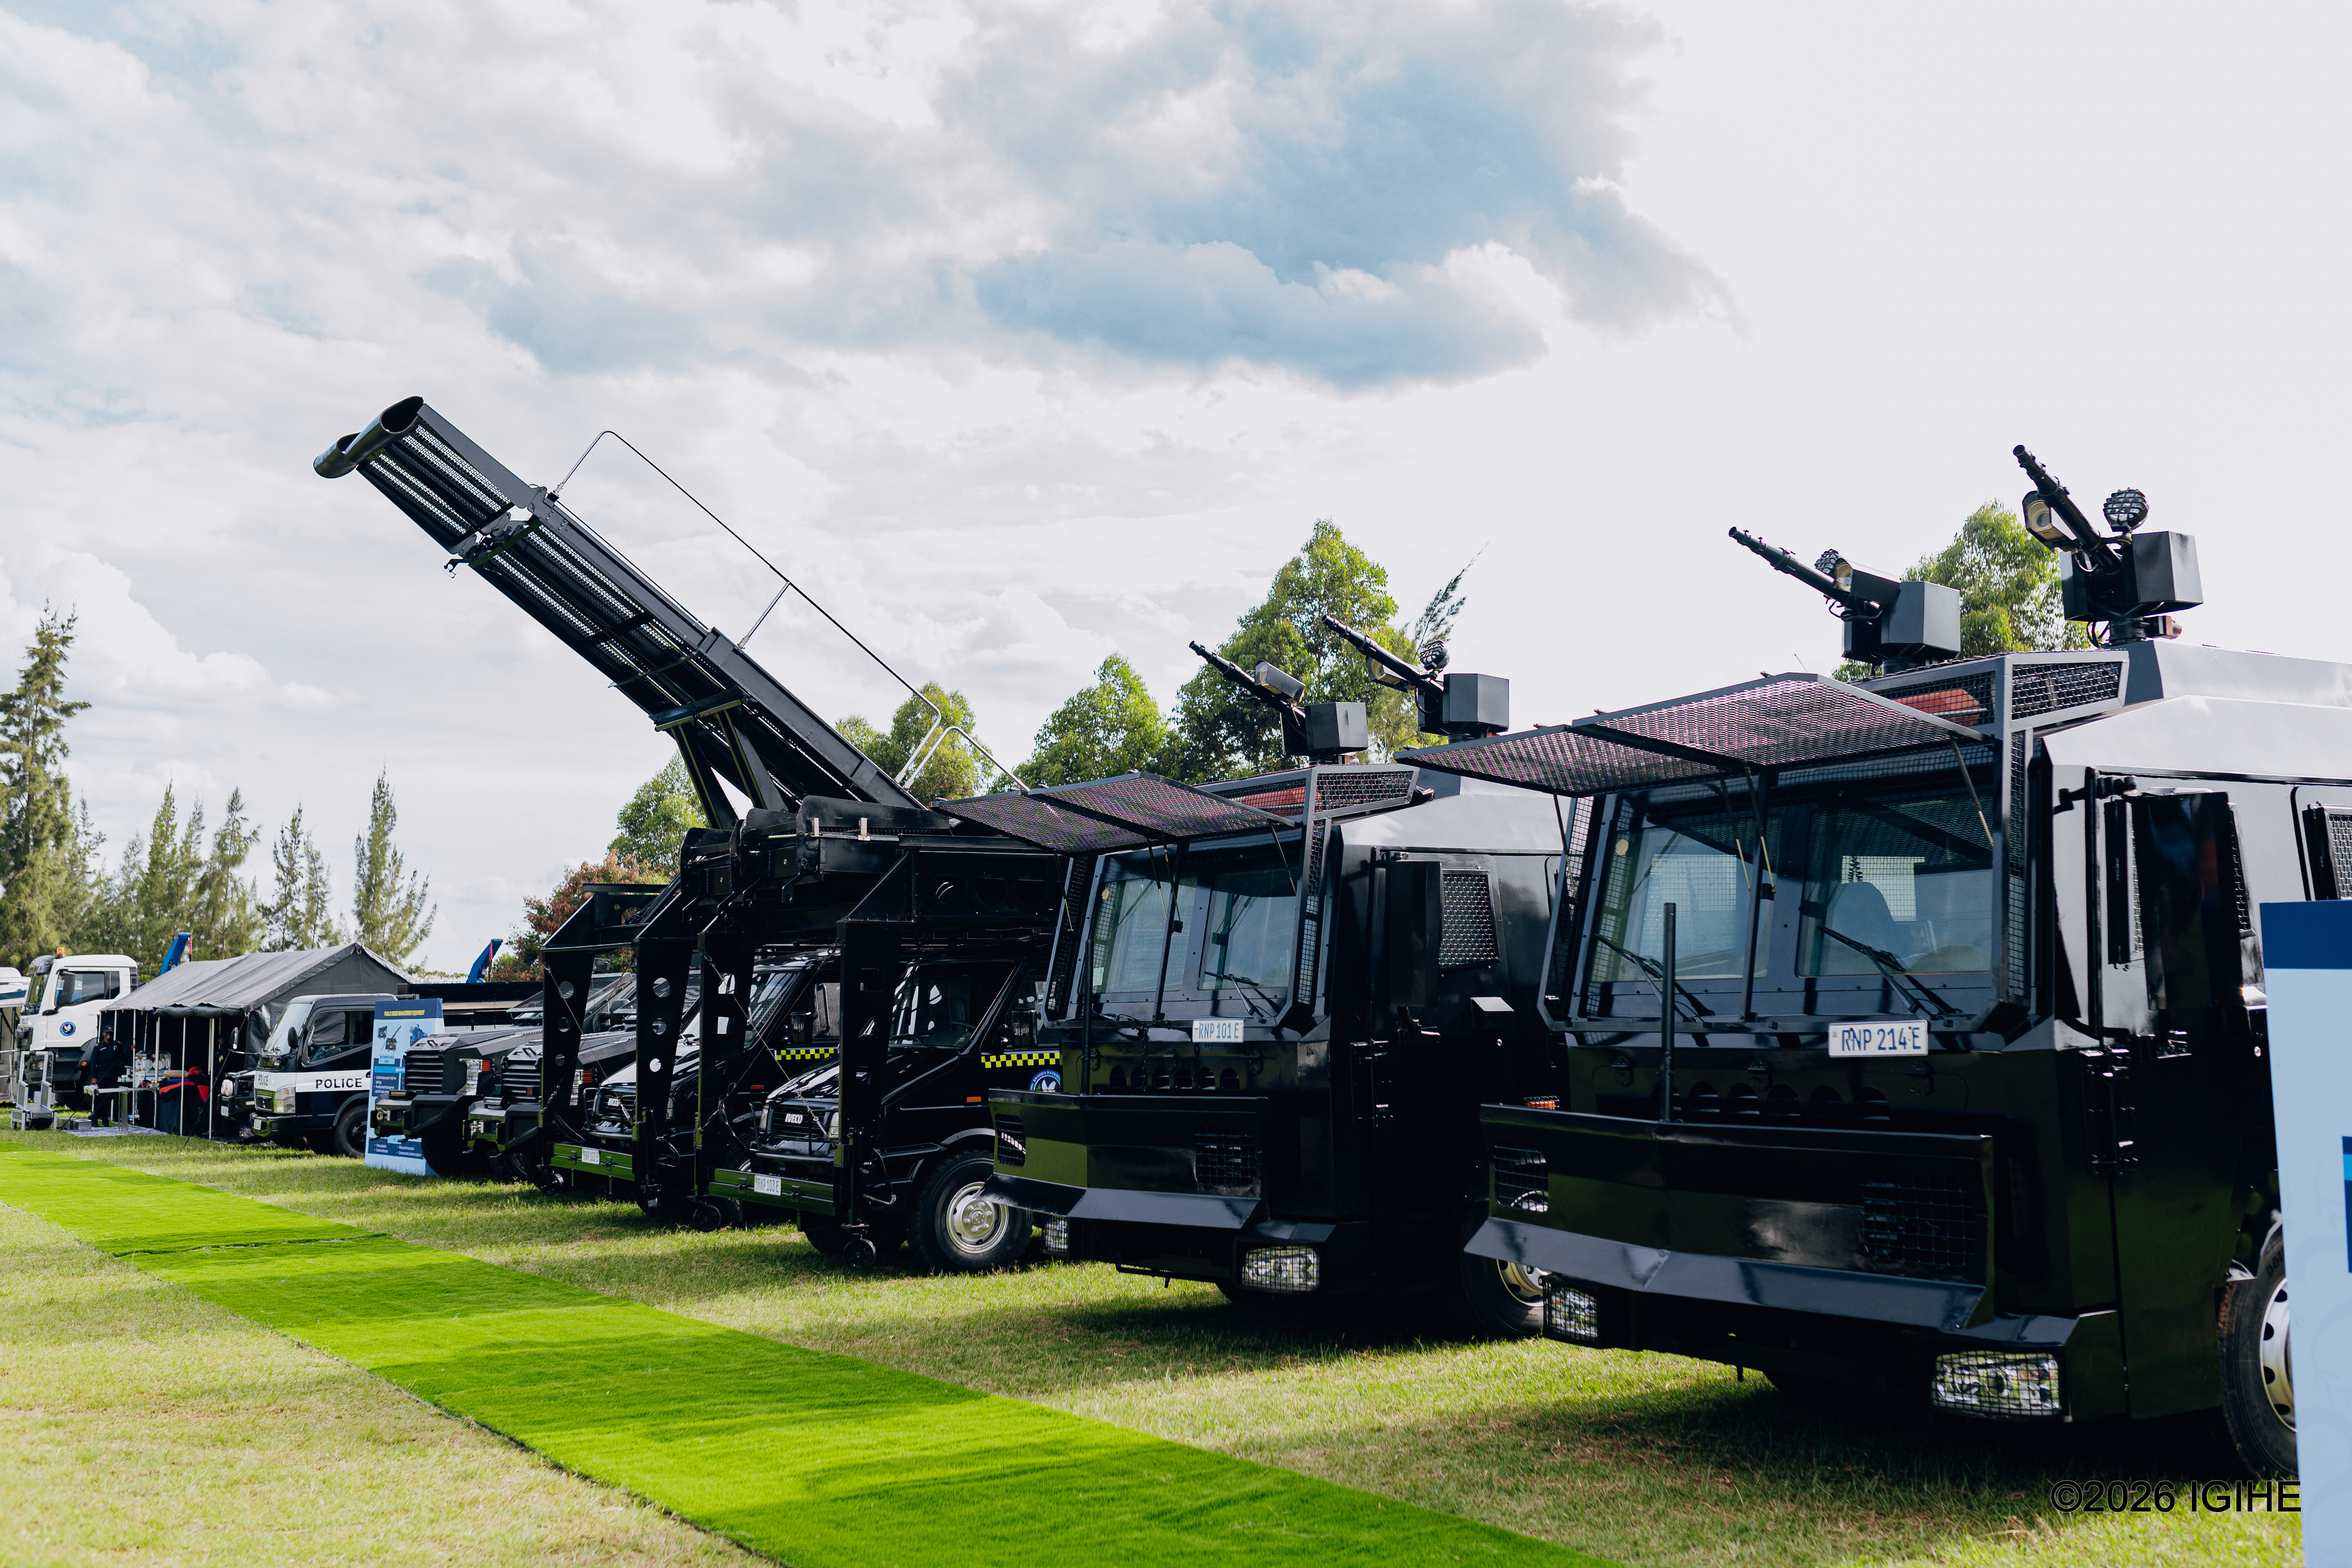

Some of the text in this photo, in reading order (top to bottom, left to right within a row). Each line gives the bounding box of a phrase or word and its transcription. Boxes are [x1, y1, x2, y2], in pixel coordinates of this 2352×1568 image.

[1199, 1023, 1214, 1039] RNP
[1216, 1023, 1231, 1038] 101
[1842, 1029, 1871, 1051] RNP
[1877, 1028, 1907, 1050] 214
[1033, 1071, 1047, 1082] RWANDA
[316, 1078, 362, 1089] POLICE
[785, 1113, 803, 1124] IVECO
[758, 1178, 766, 1191] RNP
[767, 1179, 775, 1192] 103
